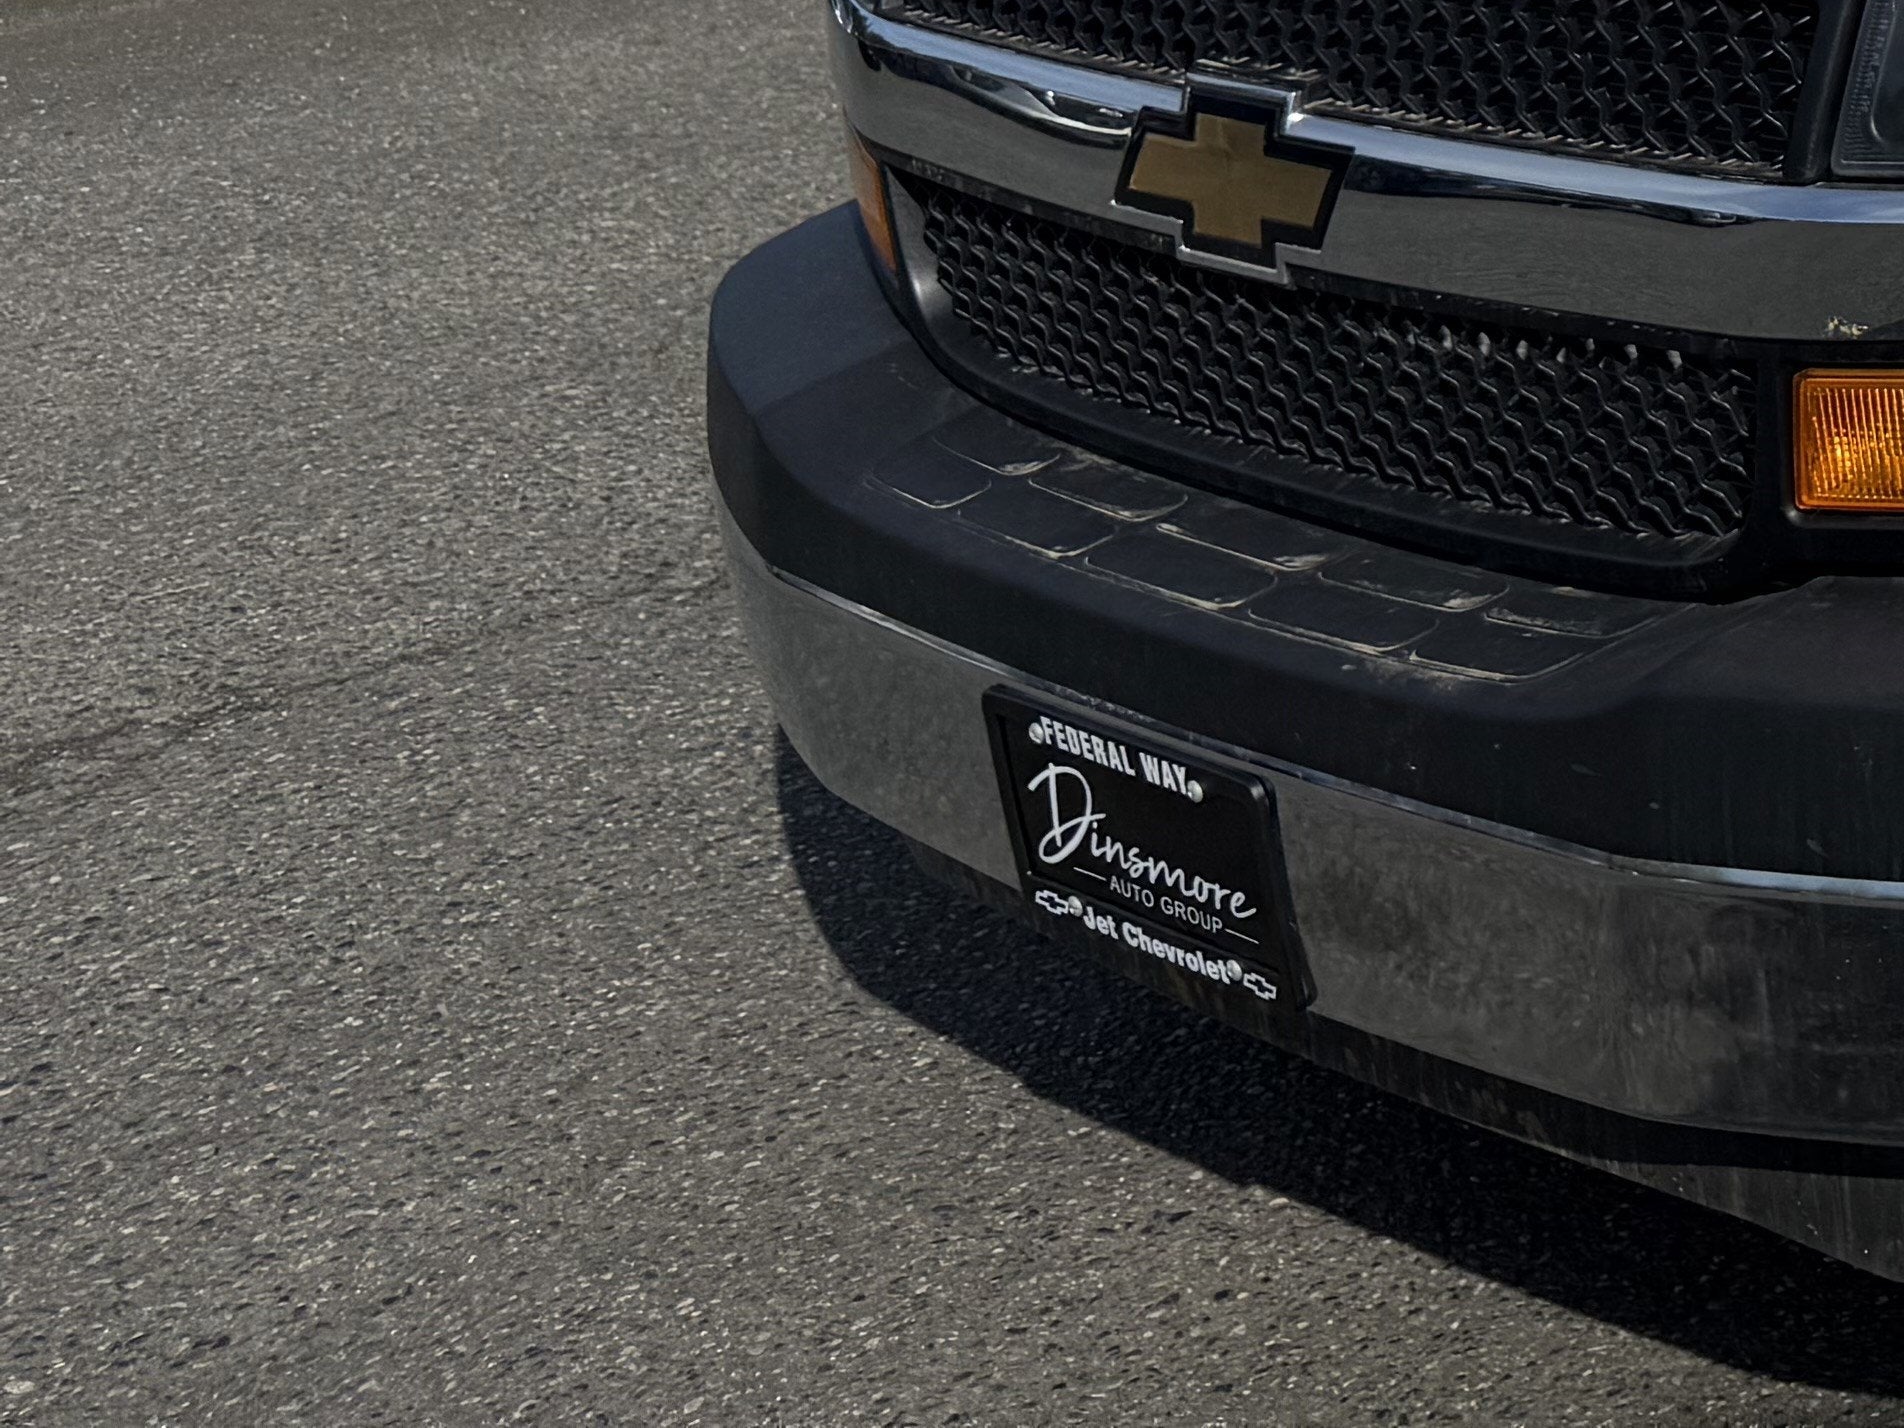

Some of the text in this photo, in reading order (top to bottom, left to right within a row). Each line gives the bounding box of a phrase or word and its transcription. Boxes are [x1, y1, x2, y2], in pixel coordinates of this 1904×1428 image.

[1039, 715, 1136, 777] FEDERAL
[1027, 762, 1258, 920] Dinsmore
[1108, 875, 1223, 934] AUTO GROUP
[1083, 906, 1232, 986] Jet Chevrolet
